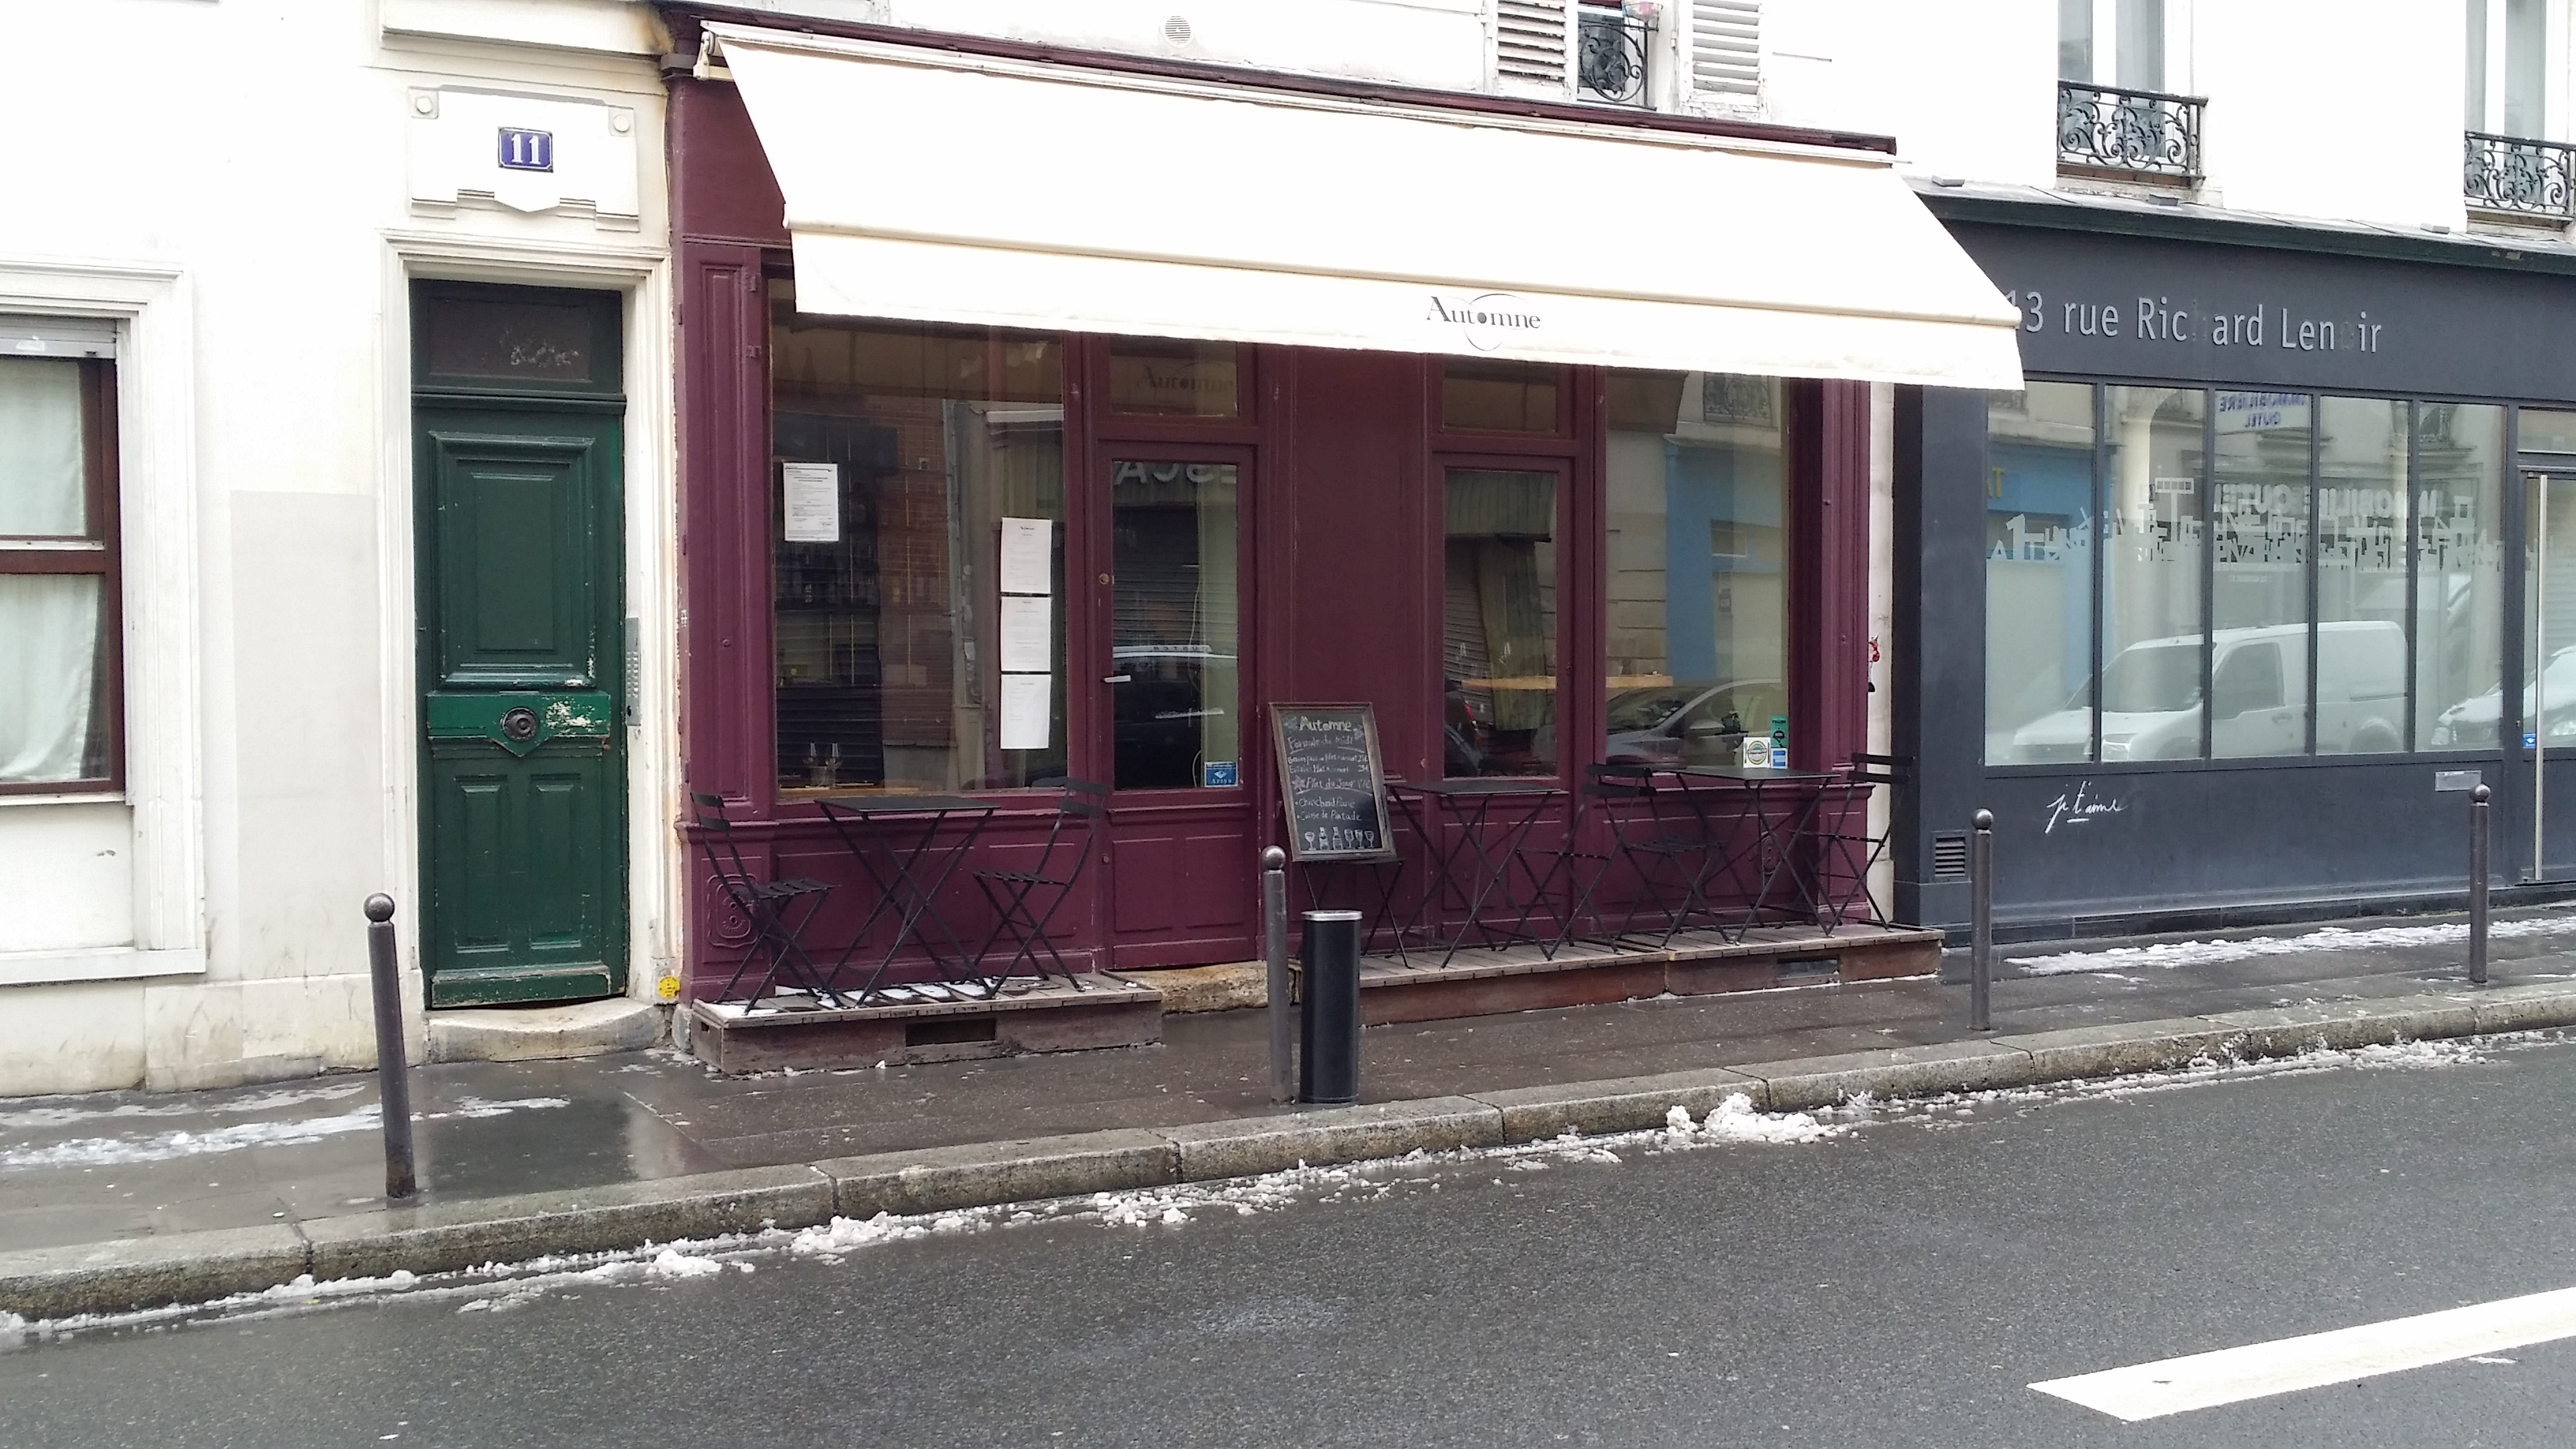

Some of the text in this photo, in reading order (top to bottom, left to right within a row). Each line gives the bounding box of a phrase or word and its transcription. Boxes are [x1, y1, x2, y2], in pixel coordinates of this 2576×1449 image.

[510, 134, 541, 165] 11
[1427, 295, 1541, 329] Automne
[2063, 301, 2119, 336] rue
[1299, 716, 1352, 731] Automne
